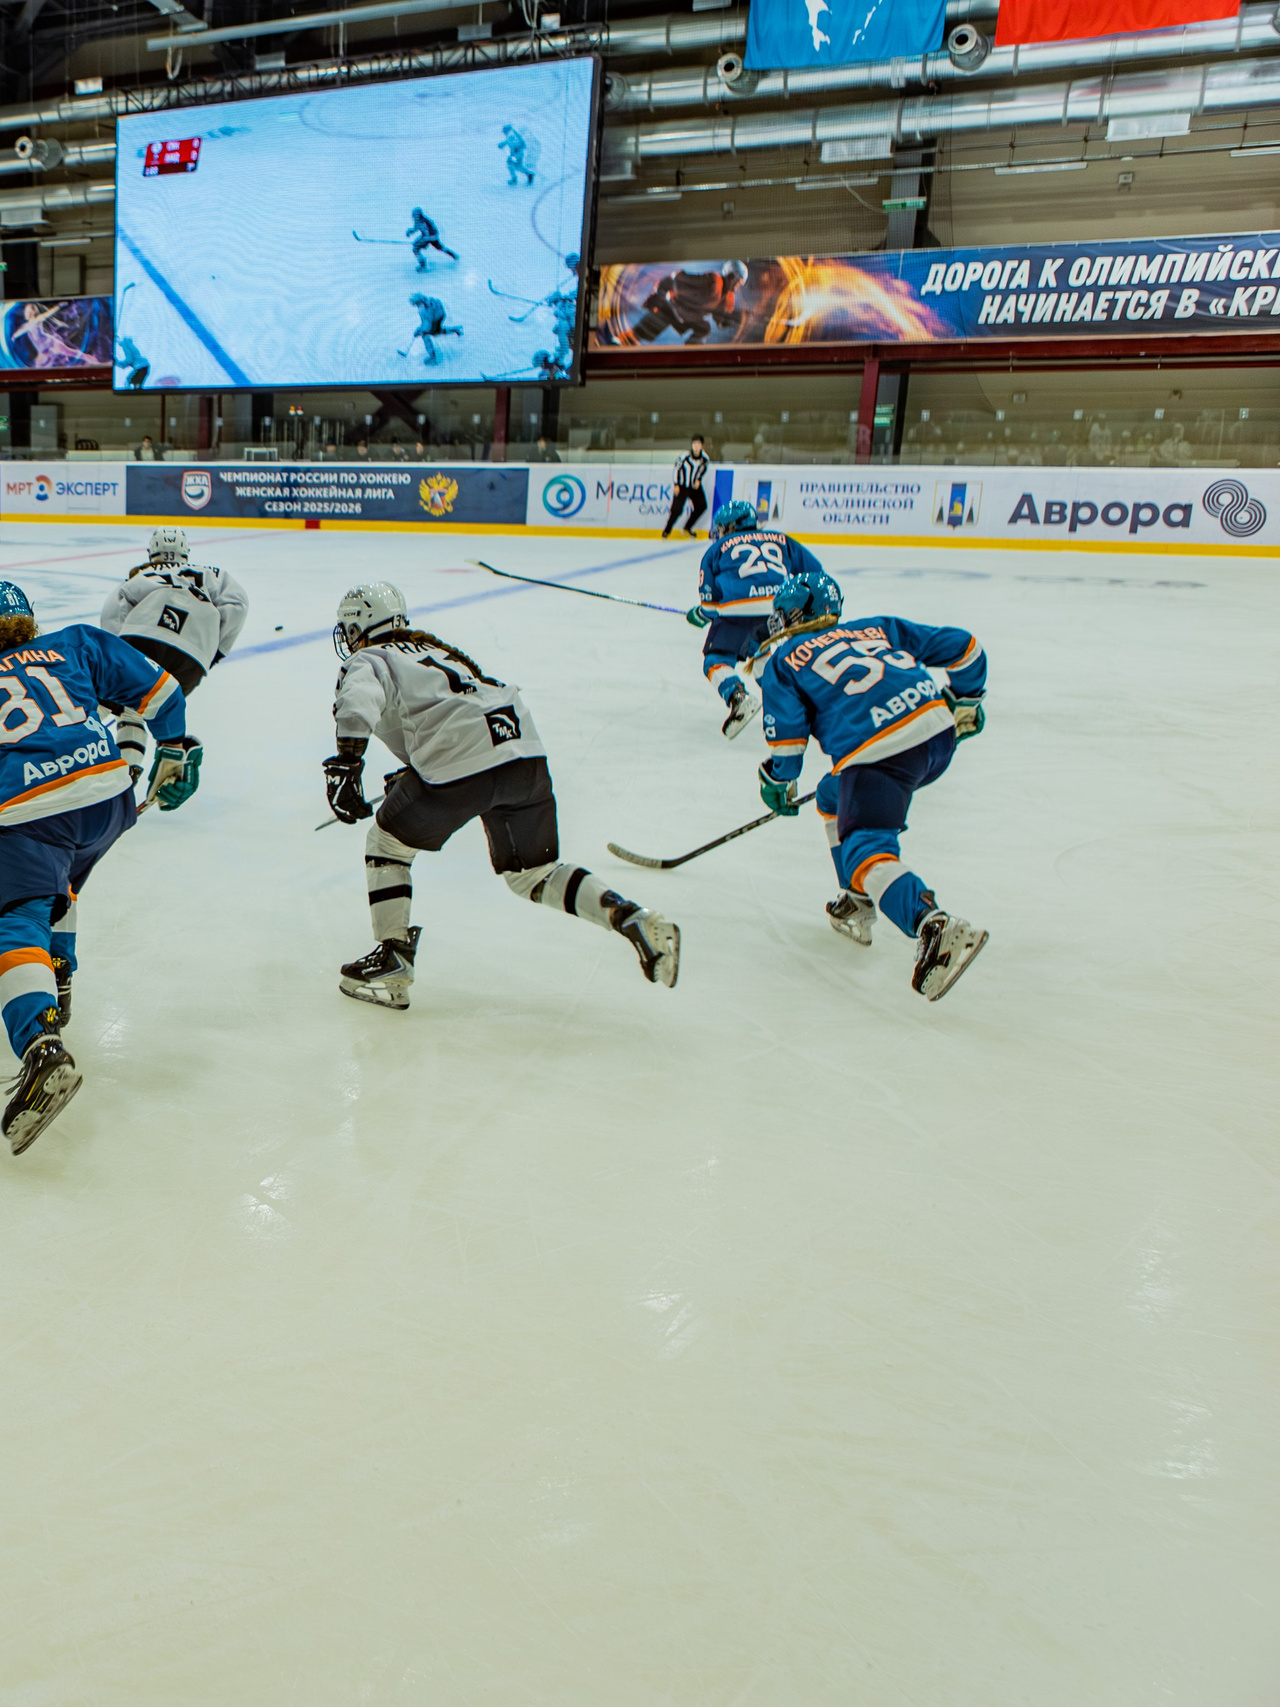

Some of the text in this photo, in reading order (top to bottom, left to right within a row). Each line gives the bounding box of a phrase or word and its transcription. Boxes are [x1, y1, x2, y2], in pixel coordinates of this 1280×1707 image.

[921, 259, 1031, 296] ДОРОГА
[1038, 258, 1064, 289] К
[977, 289, 1173, 325] НАЧИНАЕТСЯ
[1174, 288, 1200, 319] В
[220, 471, 412, 485] ЧЕМПИОНАТ РОССИИ ПО ХОККЕЮ
[6, 481, 120, 496] МРТ ЭКСПЕРТ
[235, 485, 395, 499] ЖЕНСКАЯ ХОККЕЙНАЯ ЛИГА
[596, 480, 672, 504] Медск
[799, 481, 921, 496] ПРАВИТЕЛЬСТВО
[264, 502, 363, 514] СЕЗОН 2025/2026
[802, 495, 914, 510] САХАЛИНСКОЙ
[822, 512, 890, 526] ОБЛАСТИ
[1007, 491, 1194, 535] Аврора
[721, 532, 787, 553] КИРИЧЕНКО
[163, 551, 176, 561] 33
[730, 542, 789, 580] 29
[23, 739, 112, 786] Аврора
